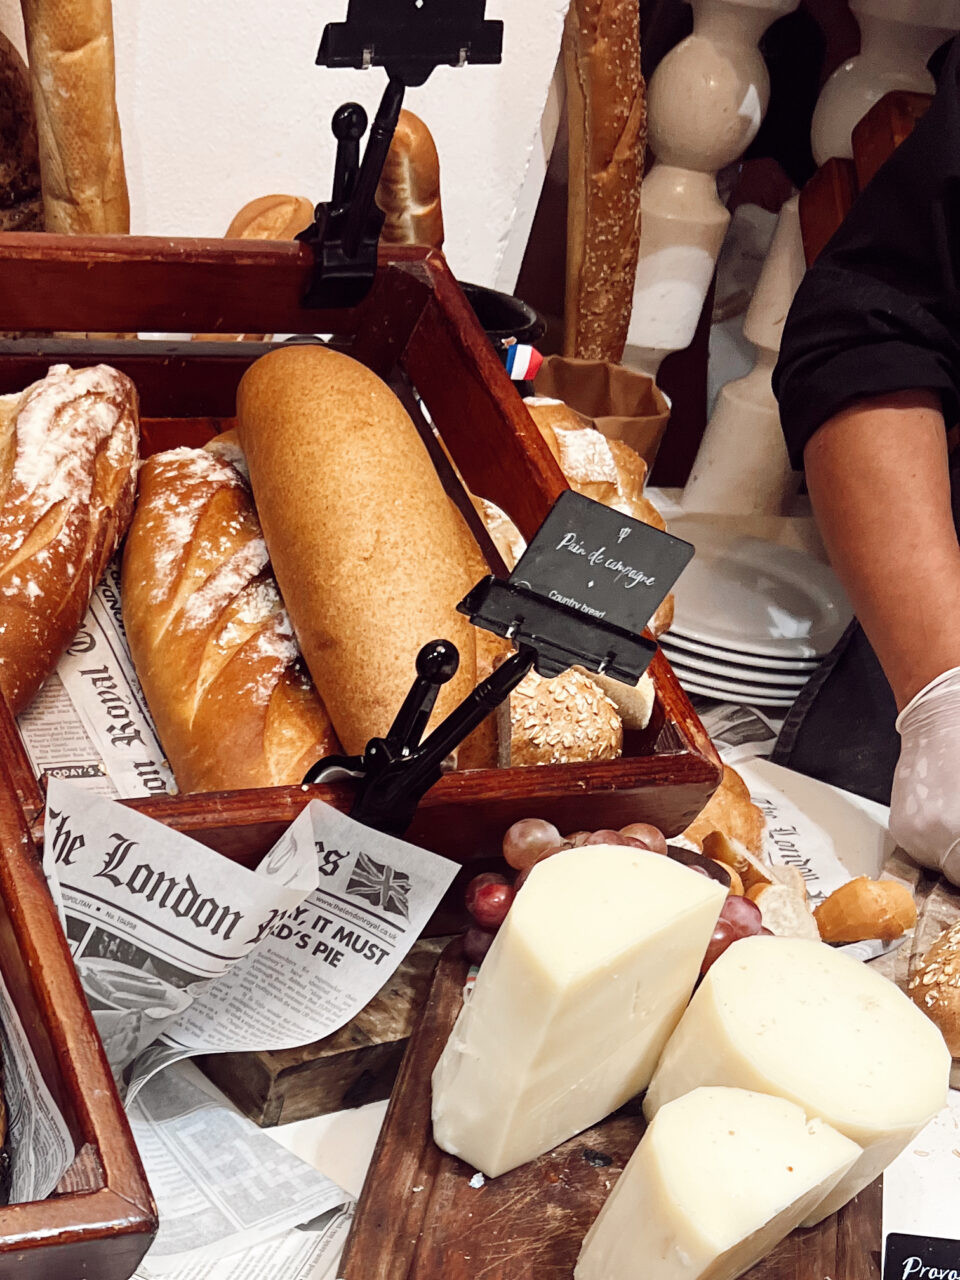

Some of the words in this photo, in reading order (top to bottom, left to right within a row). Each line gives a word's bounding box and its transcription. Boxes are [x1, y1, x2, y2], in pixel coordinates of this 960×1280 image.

[555, 532, 586, 555] Pain
[588, 547, 604, 565] de
[605, 557, 655, 589] campagne
[548, 590, 582, 611] Country
[581, 602, 606, 619] bread
[78, 665, 147, 748] Royal
[768, 826, 820, 882] London
[93, 833, 243, 940] London
[312, 915, 333, 932] IT
[336, 925, 390, 966] MUST
[312, 940, 345, 968] PIE
